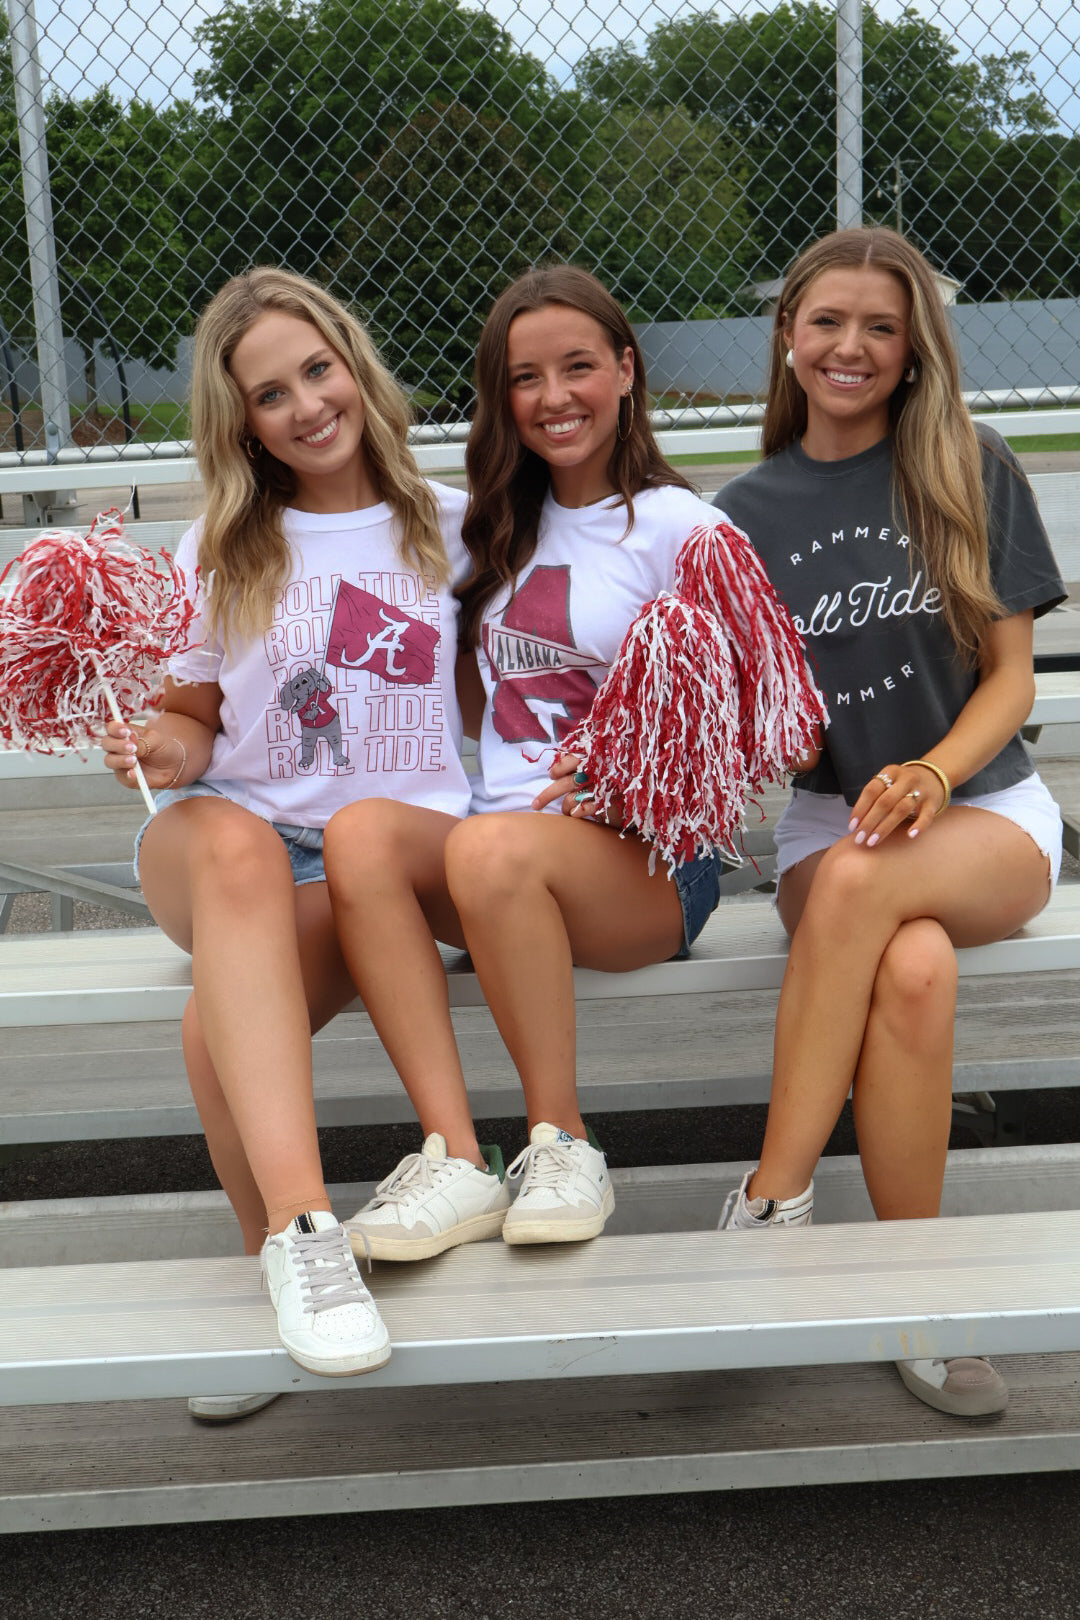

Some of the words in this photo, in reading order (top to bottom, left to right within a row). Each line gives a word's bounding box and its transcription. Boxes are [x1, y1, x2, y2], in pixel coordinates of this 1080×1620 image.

[790, 526, 910, 566] RAMMER
[359, 571, 440, 608] TIDE
[791, 591, 843, 636] oll
[848, 570, 944, 627] Tide
[263, 615, 330, 666] ROL
[496, 634, 563, 672] ALABAMA
[836, 663, 915, 705] MMER
[364, 693, 444, 732] TIDE
